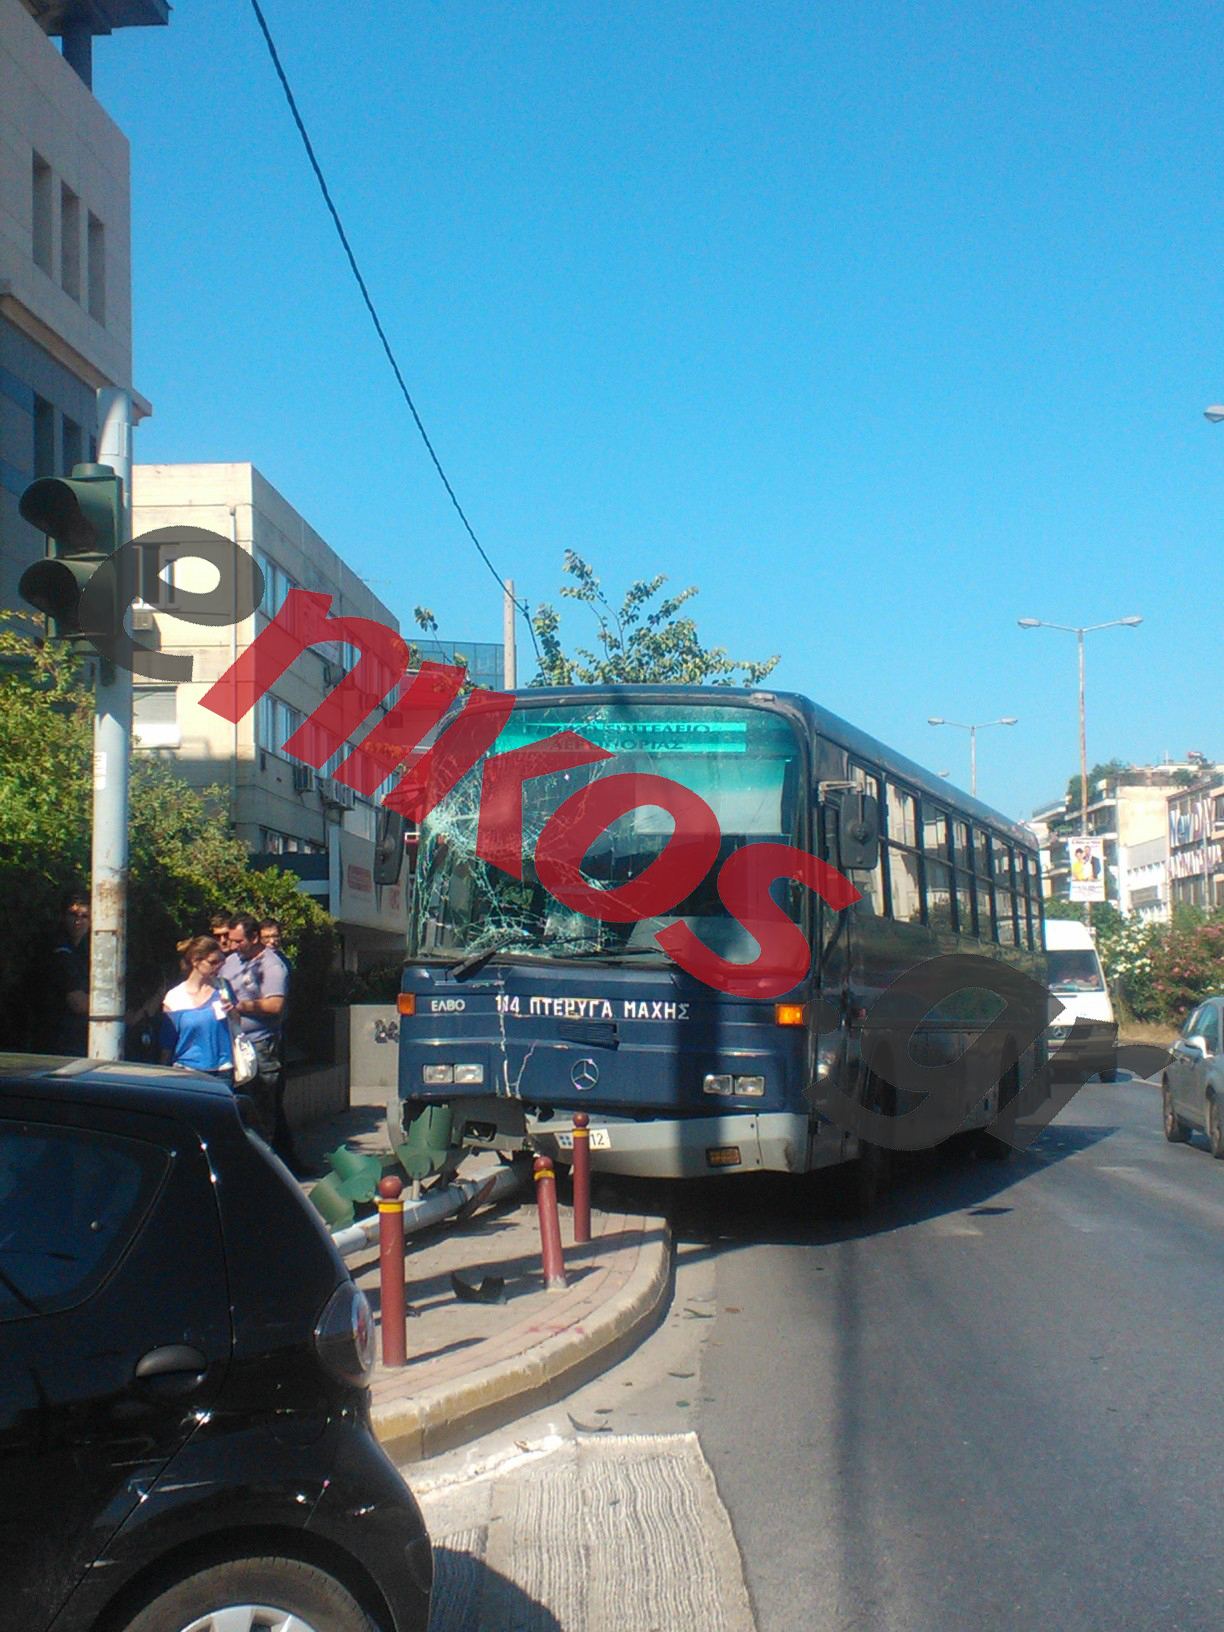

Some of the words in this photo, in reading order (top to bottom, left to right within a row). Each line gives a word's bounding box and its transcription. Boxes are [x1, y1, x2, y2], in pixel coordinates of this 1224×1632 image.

[431, 999, 466, 1012] ΕΛΒΟ
[495, 995, 520, 1013] 114
[529, 997, 613, 1016] ΠΤΕΡΥΓΑ
[624, 1000, 690, 1020] ΜΑΧΗΣ
